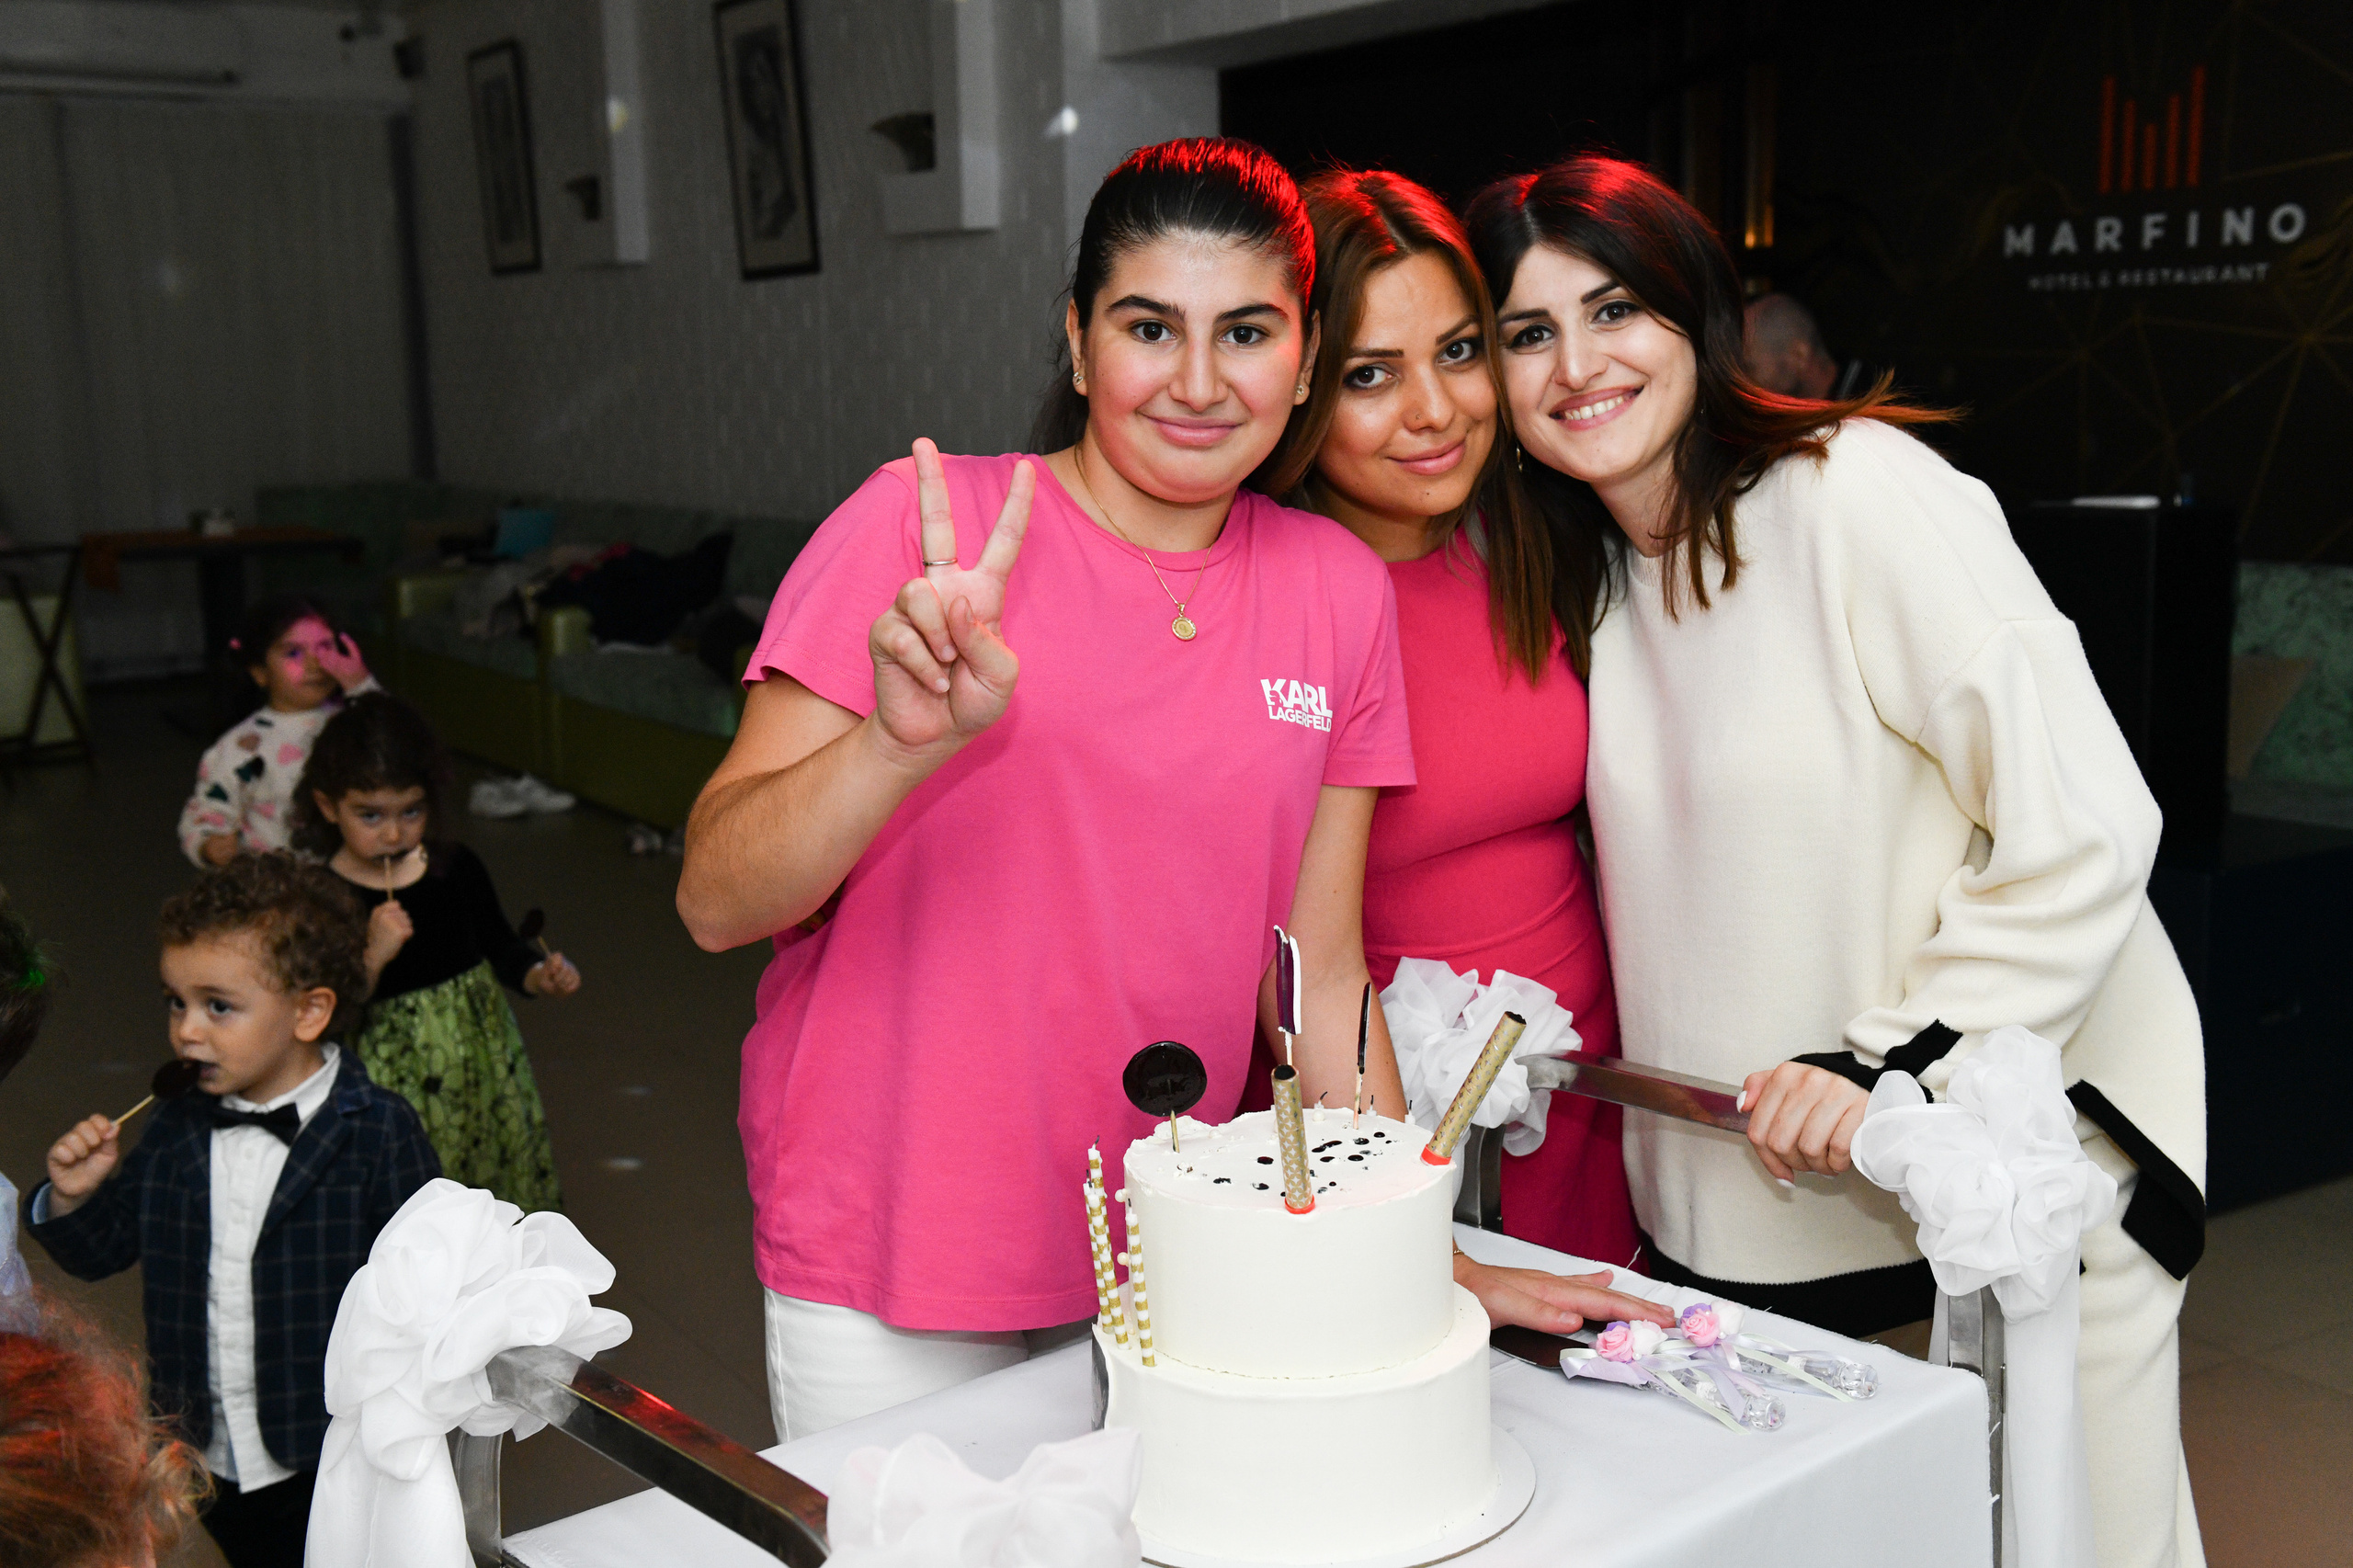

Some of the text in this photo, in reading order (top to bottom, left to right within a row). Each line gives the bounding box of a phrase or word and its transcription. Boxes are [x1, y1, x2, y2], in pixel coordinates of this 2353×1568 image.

[2004, 202, 2307, 258] MARFINO
[1260, 678, 1333, 719] KARL
[1268, 705, 1332, 733] LAGERFELD
